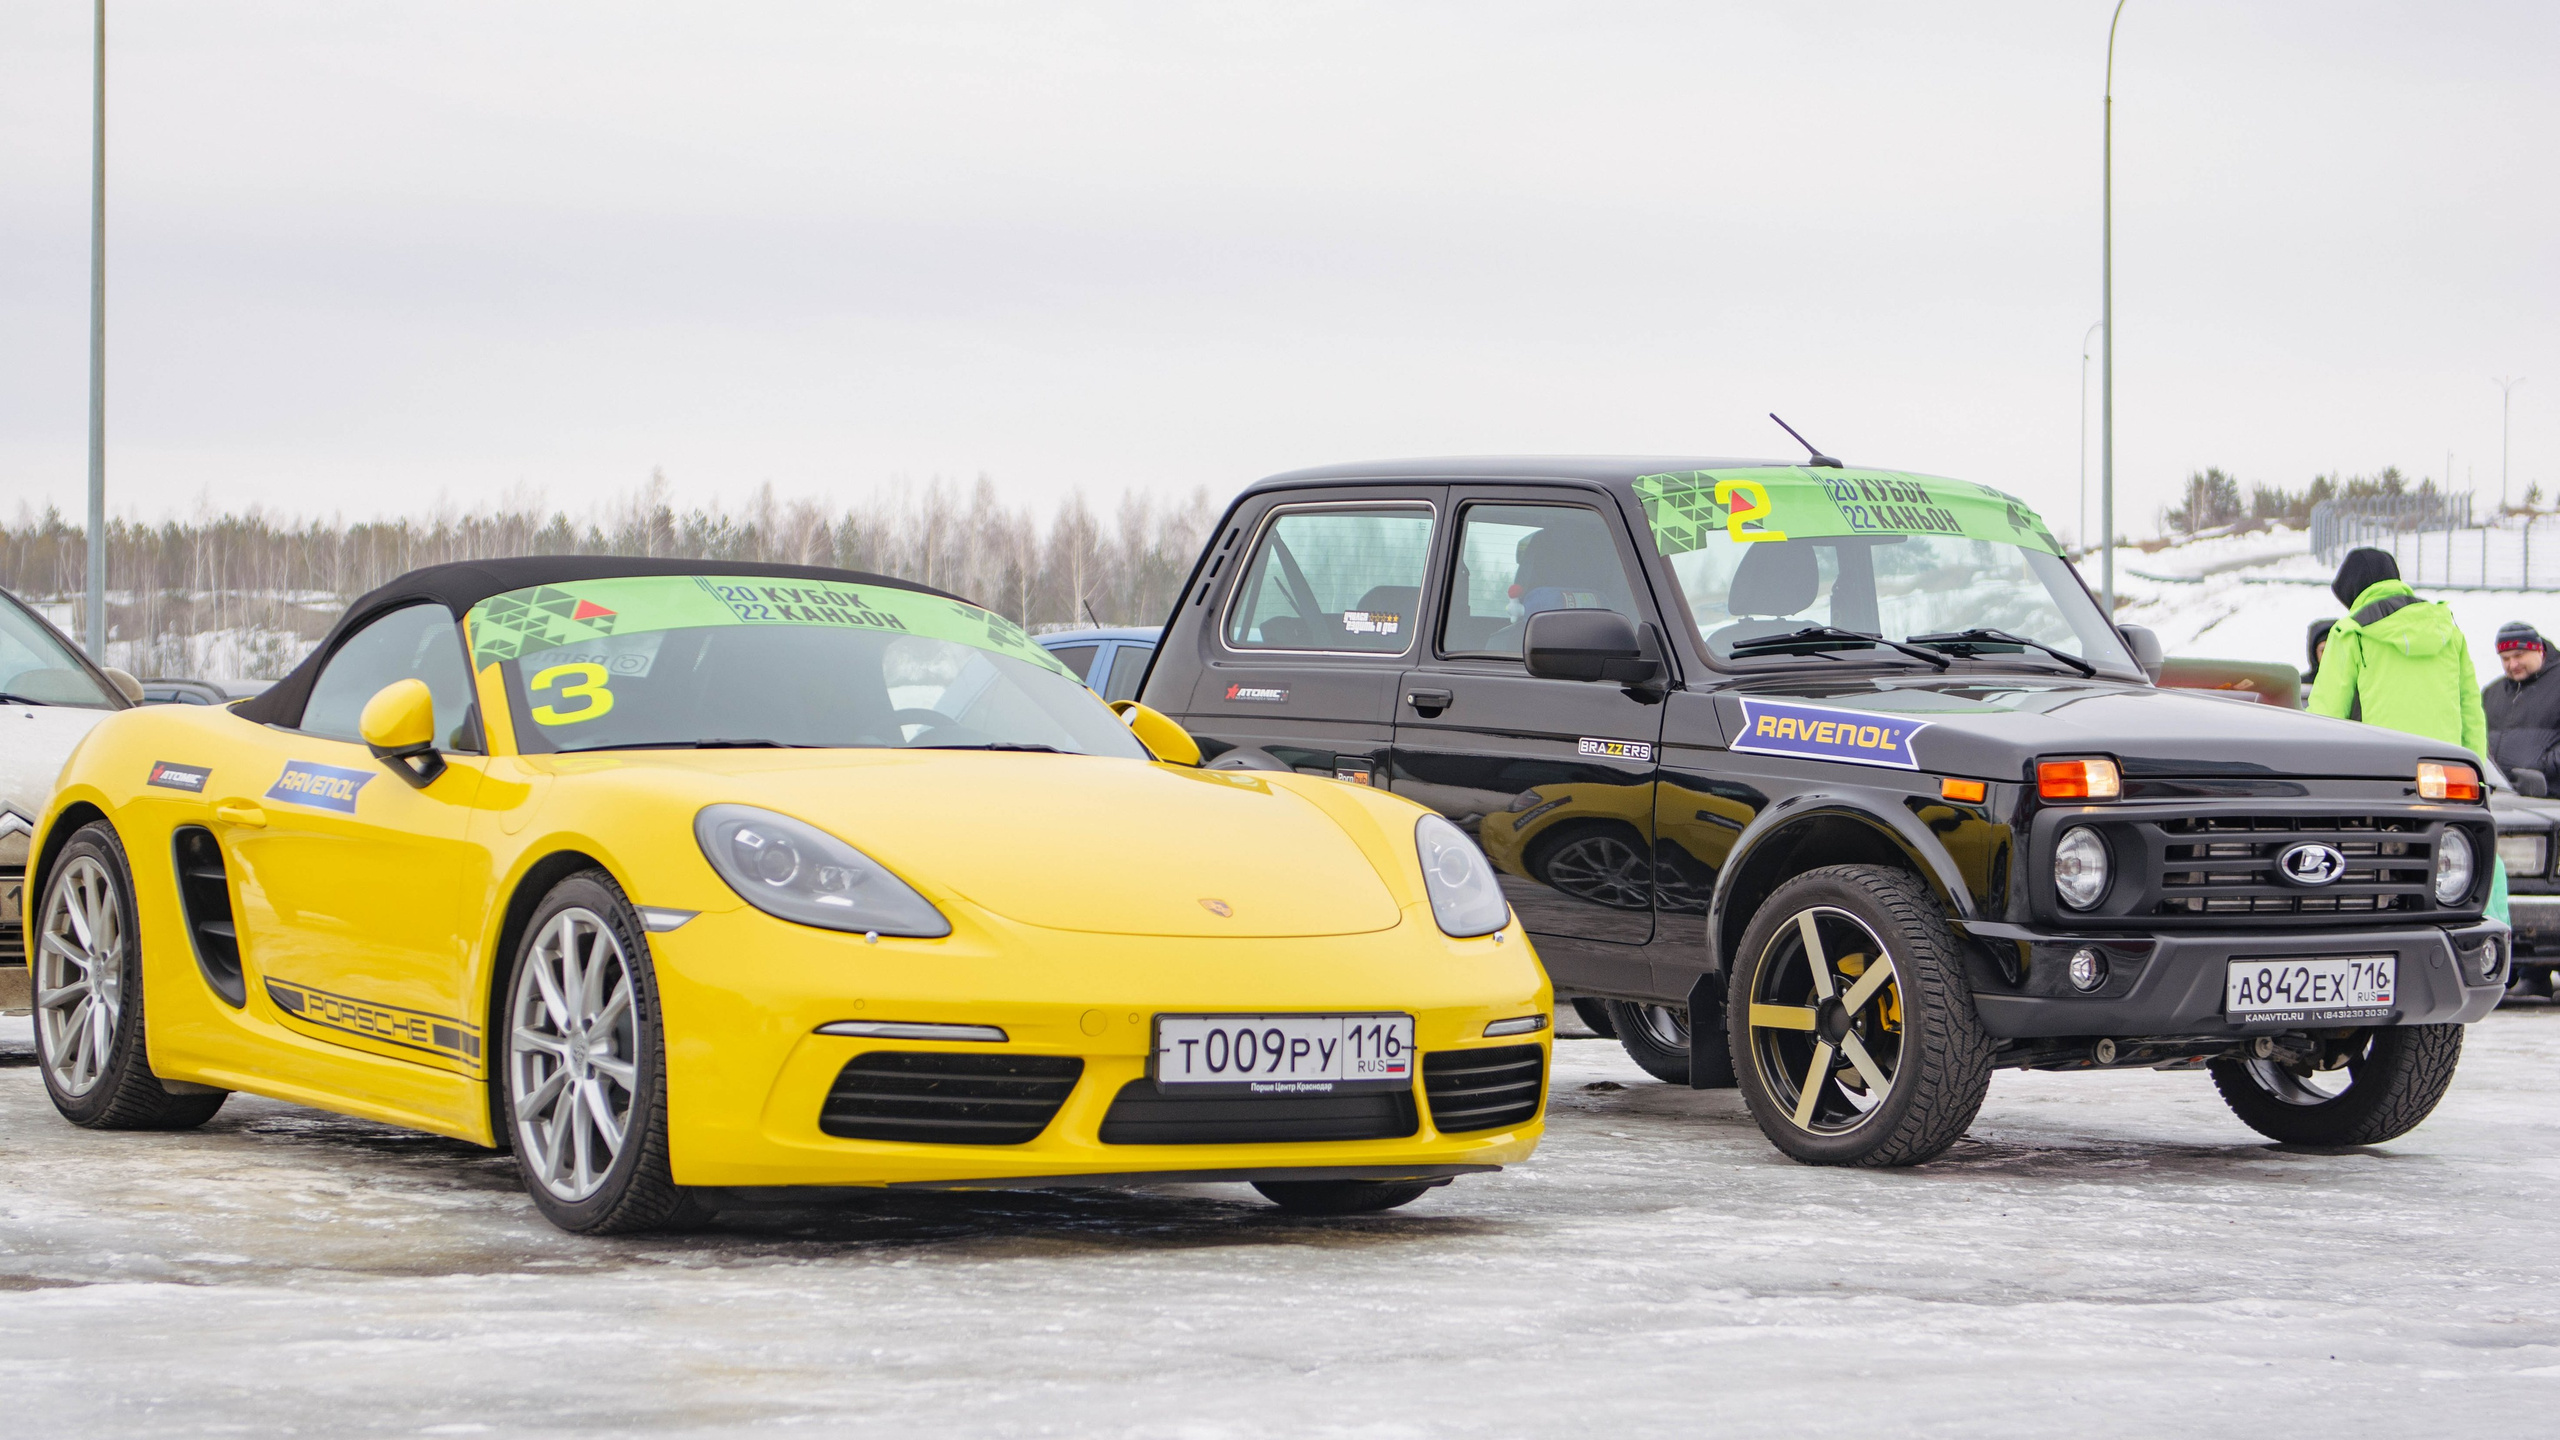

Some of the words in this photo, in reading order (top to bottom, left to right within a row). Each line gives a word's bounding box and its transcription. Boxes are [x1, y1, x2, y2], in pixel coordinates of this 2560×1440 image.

[1825, 478, 1859, 502] 20
[1854, 478, 1933, 505] КУБОК
[1714, 480, 1788, 543] 2
[1842, 505, 1877, 529] 22
[1869, 505, 1963, 532] КАНЬОН
[717, 586, 759, 602] 20
[759, 586, 871, 609] КУБОК
[734, 603, 777, 620] 22
[775, 604, 907, 630] КАНЬОН
[530, 662, 615, 726] 3
[1236, 688, 1281, 697] ATOMIC
[1756, 715, 1898, 750] RAVENOL
[1580, 741, 1649, 758] BRAZZERS
[159, 770, 201, 784] ATOMIC
[2350, 962, 2388, 991] 716
[2357, 991, 2376, 1002] RUS
[308, 994, 428, 1042] PORSCHE
[2245, 1012, 2305, 1022] KANAVTO.RU
[1347, 1024, 1401, 1058] 116
[1357, 1060, 1385, 1073] RUS
[1250, 1082, 1274, 1093] Порше
[1275, 1082, 1296, 1093] Центр
[1296, 1082, 1333, 1093] Краснодар
